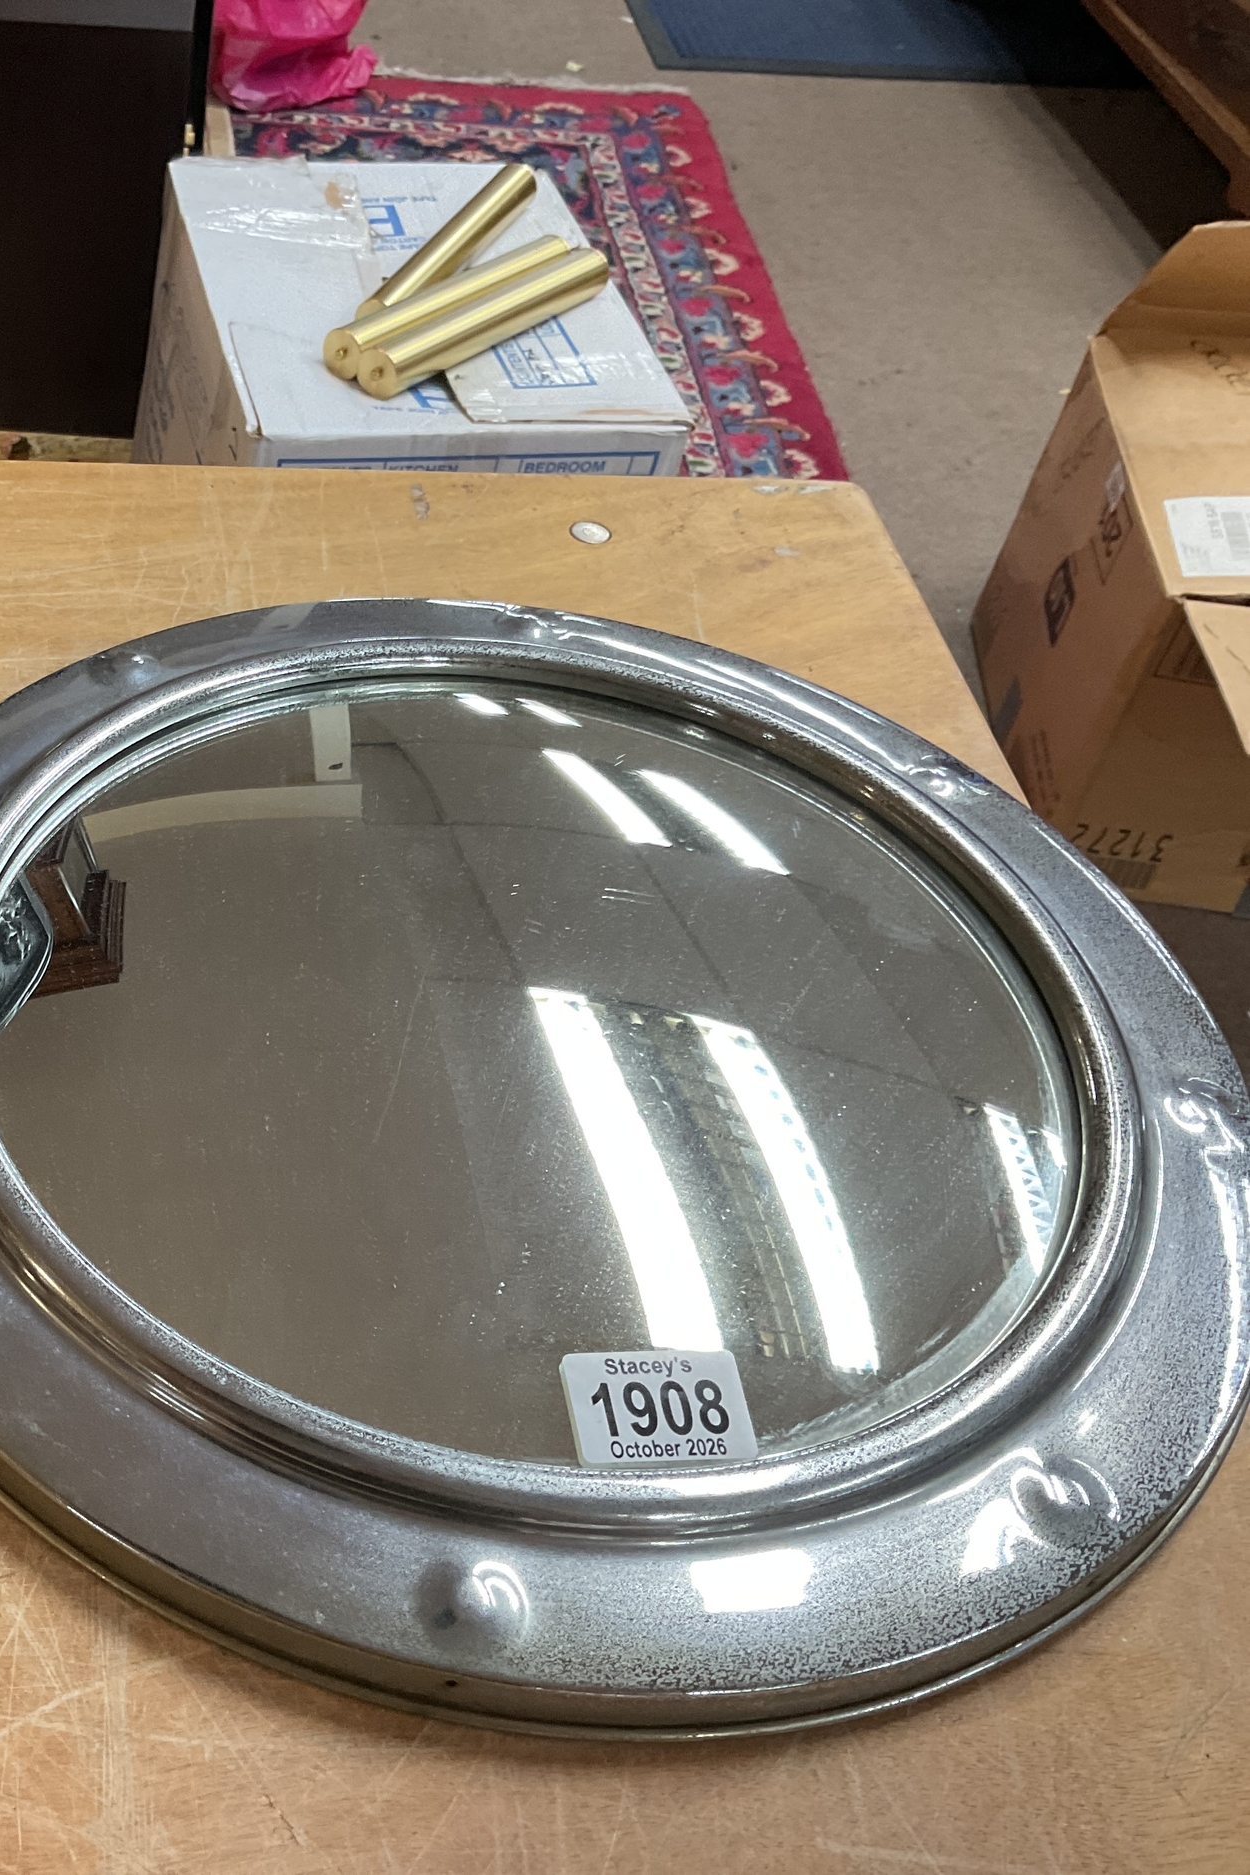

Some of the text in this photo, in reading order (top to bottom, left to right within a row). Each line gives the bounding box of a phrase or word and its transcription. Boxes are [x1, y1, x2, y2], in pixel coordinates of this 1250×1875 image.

[523, 461, 607, 474] BEDROOM
[604, 1357, 693, 1377] Stacey's
[591, 1379, 730, 1437] 1908
[610, 1438, 728, 1459] October 2026
